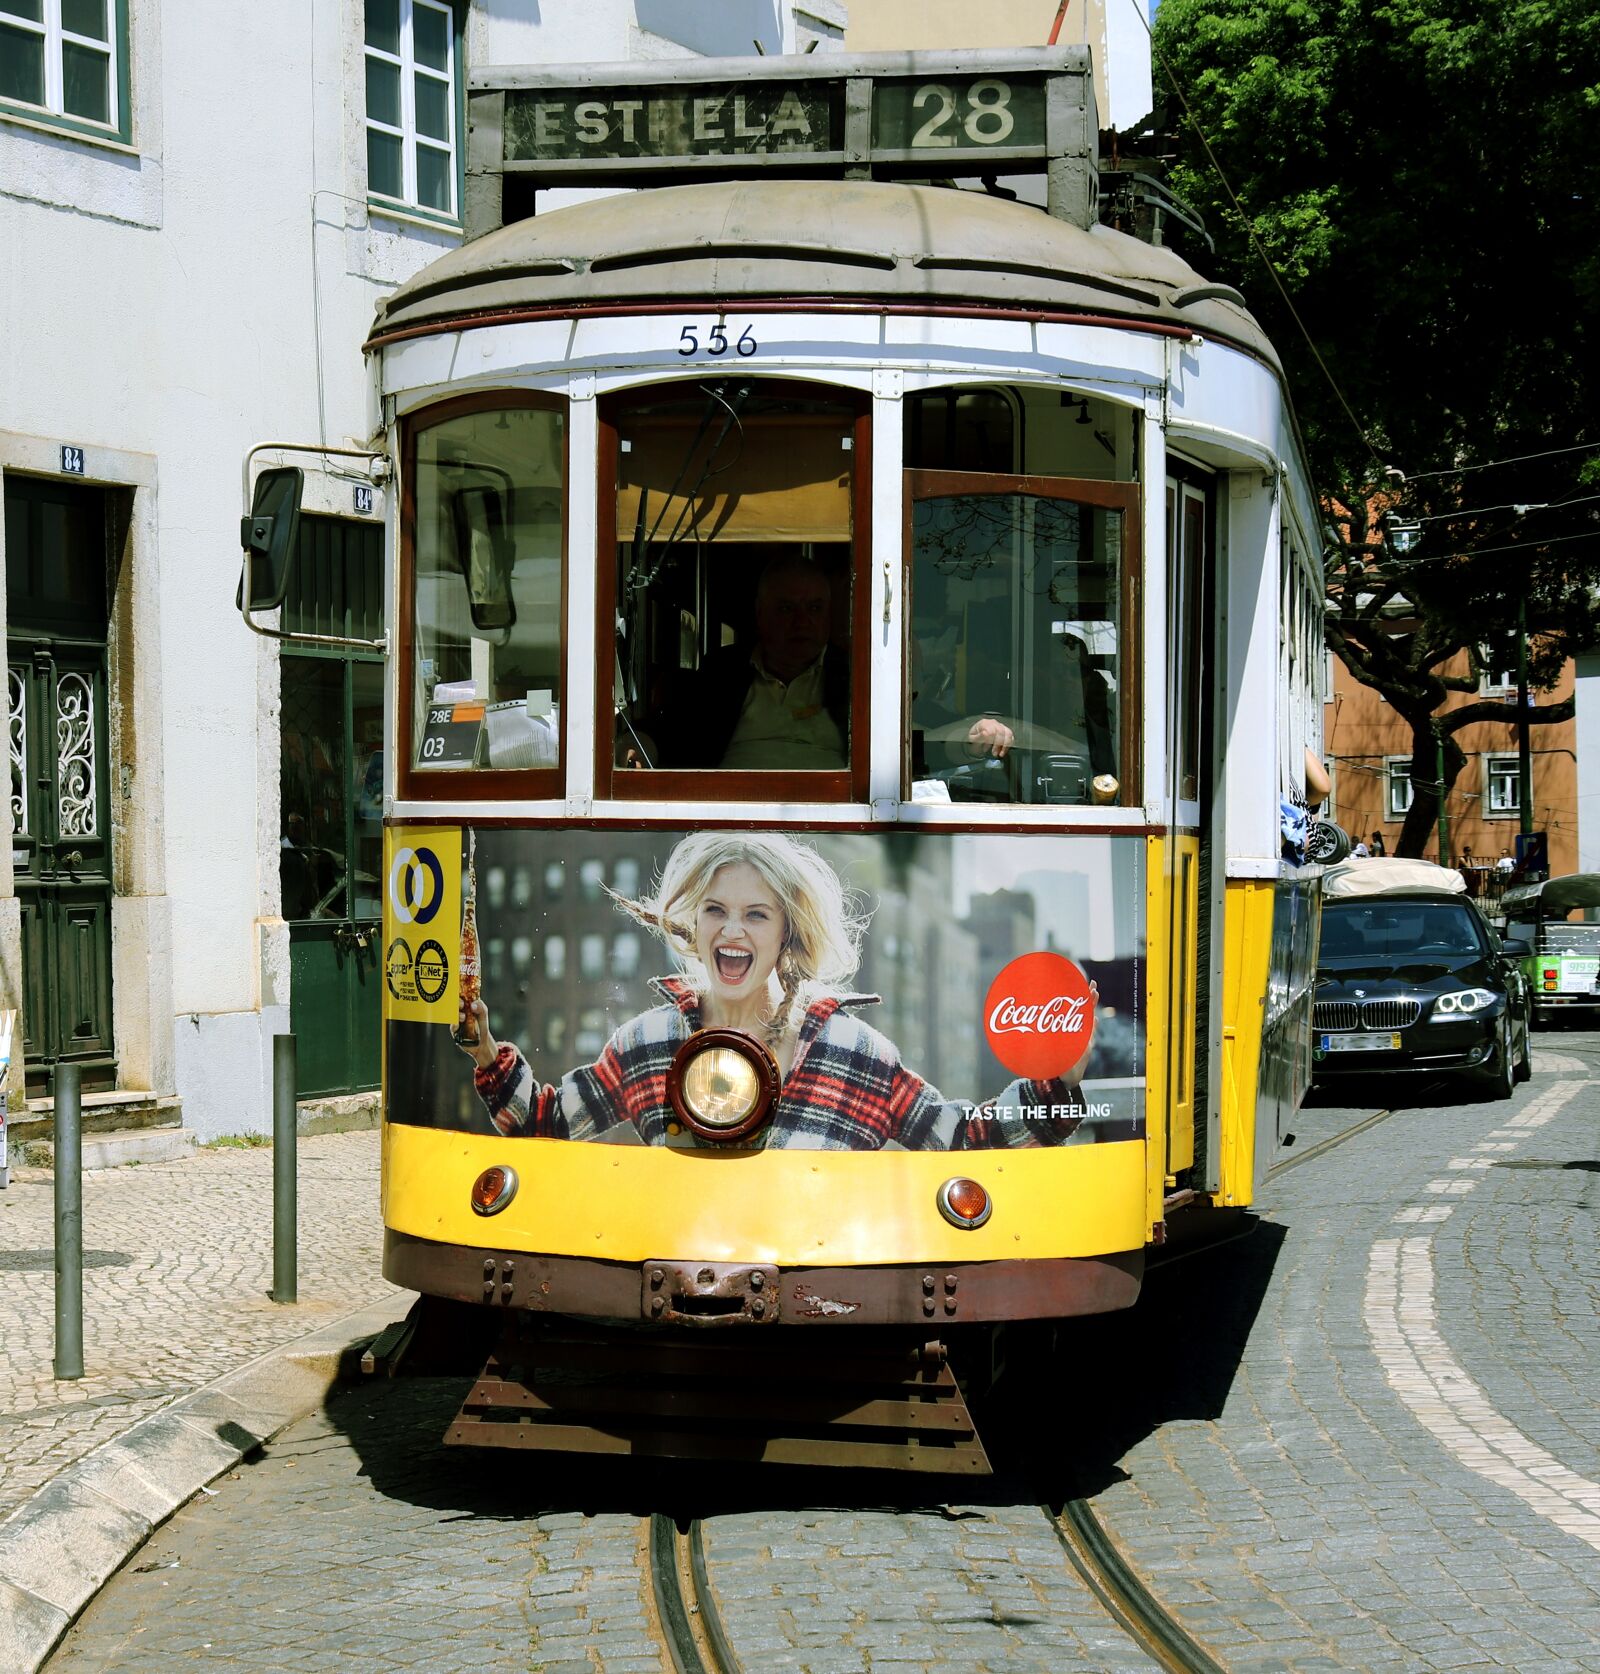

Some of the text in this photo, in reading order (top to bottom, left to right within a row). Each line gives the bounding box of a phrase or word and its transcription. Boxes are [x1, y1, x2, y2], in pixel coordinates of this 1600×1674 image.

[535, 91, 812, 145] ESTRELA
[912, 80, 1015, 149] 28
[678, 323, 758, 357] 556
[64, 447, 81, 472] 84
[429, 709, 452, 724] 28E
[423, 736, 445, 758] 03
[989, 996, 1089, 1034] Coca-Cola
[962, 1103, 1111, 1121] TASTE THE FEELING
